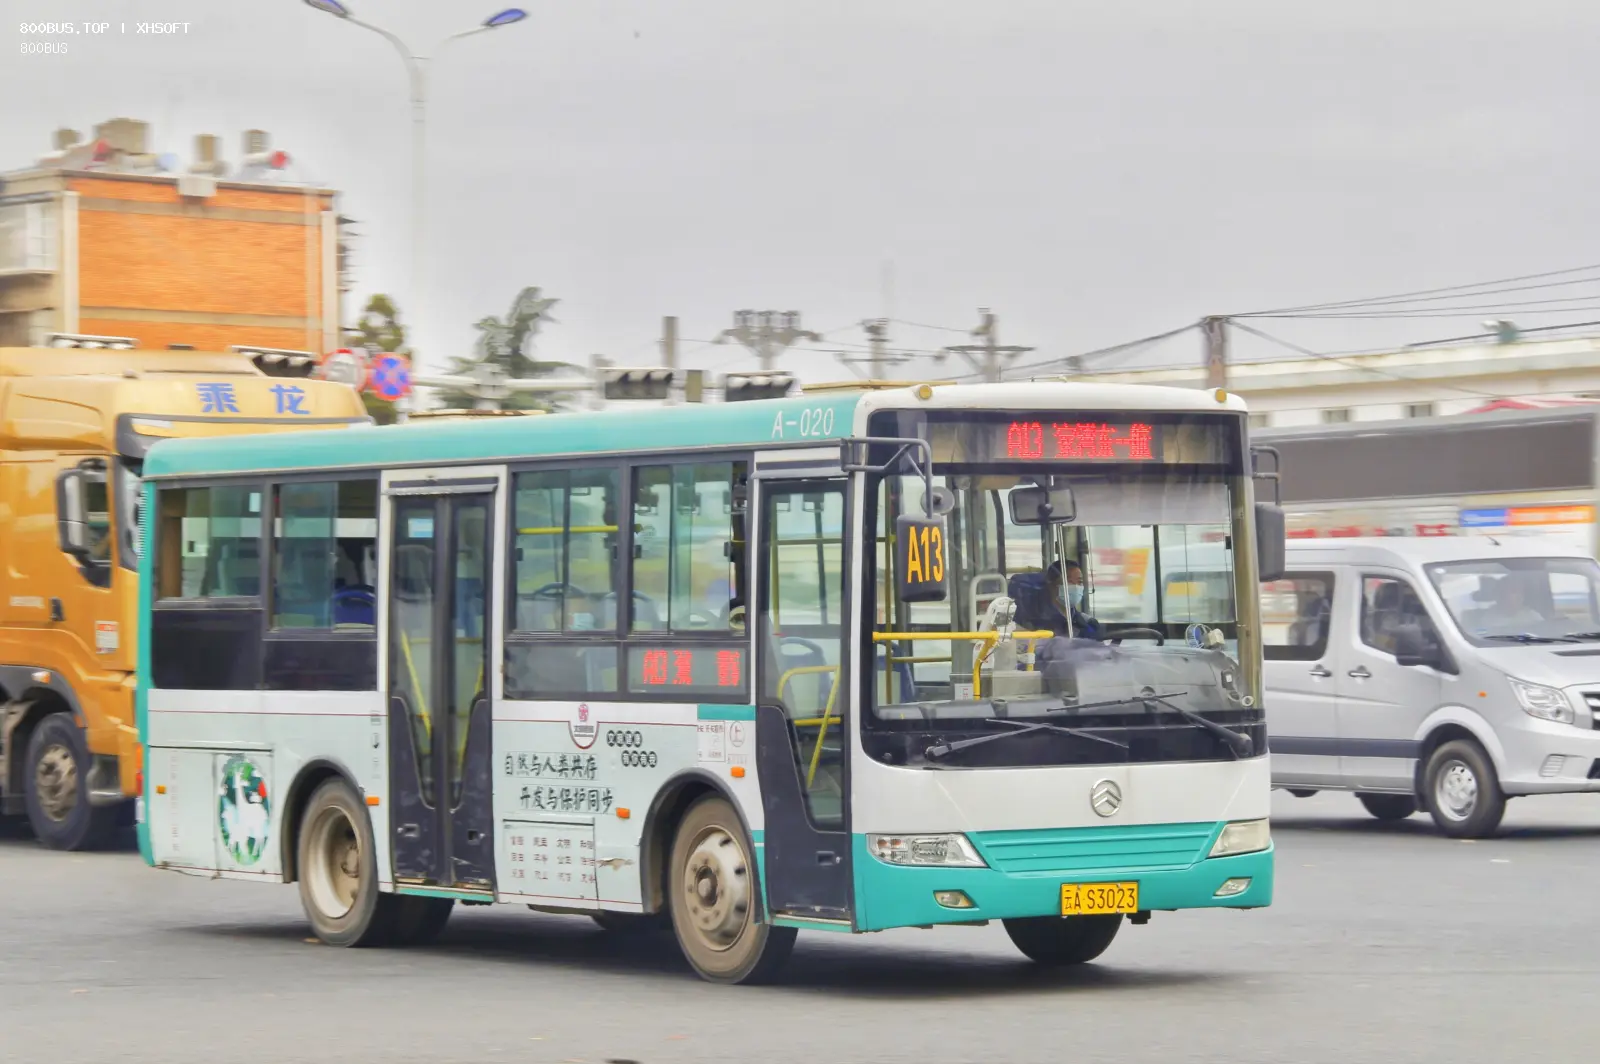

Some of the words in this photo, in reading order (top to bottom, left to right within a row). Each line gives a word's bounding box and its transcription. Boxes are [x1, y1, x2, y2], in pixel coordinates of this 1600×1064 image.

[771, 407, 834, 439] A-020
[907, 525, 944, 584] A13
[504, 752, 598, 780] 自然与人类共存
[519, 786, 615, 814] 开发与保护同步
